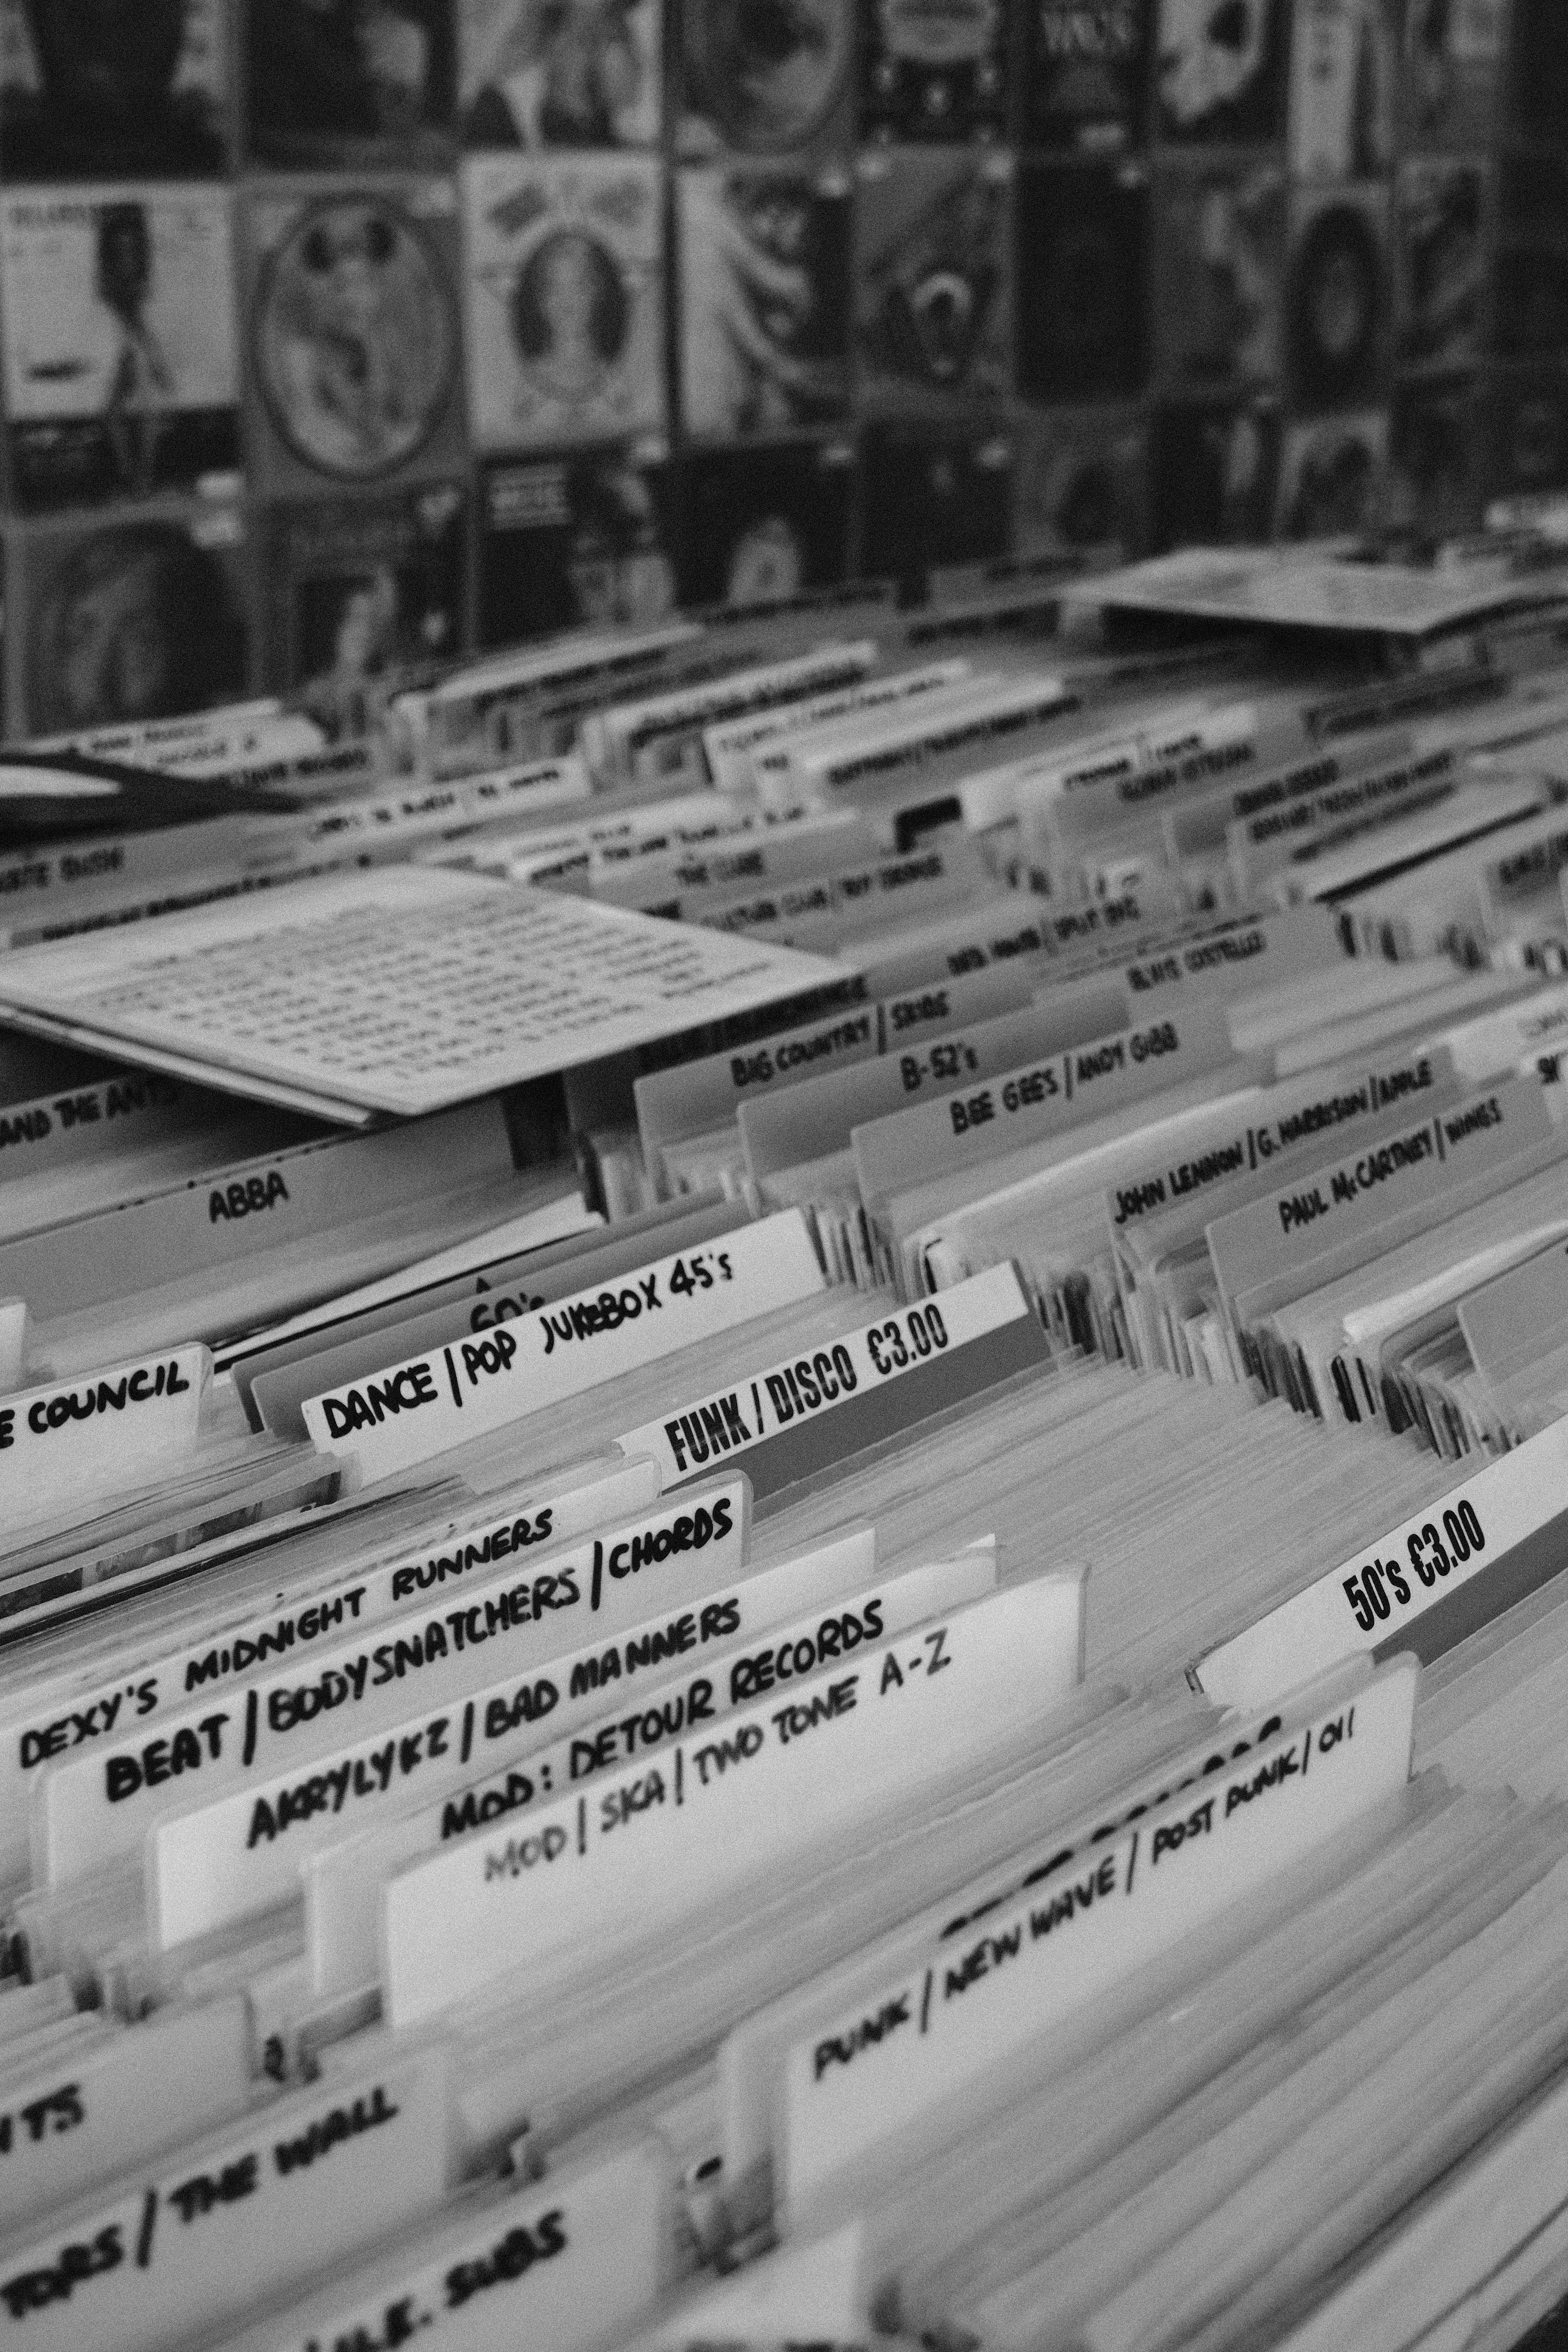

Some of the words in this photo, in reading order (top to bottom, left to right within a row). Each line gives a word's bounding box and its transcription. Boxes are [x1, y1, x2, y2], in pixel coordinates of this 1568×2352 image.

[1184, 930, 1267, 973] COSTELLO
[730, 1051, 775, 1087] BIG
[775, 1015, 871, 1072] COUNTRY
[949, 1089, 995, 1135] BEE
[1001, 1066, 1060, 1113] GEES
[1076, 1039, 1126, 1084] ANDY
[54, 1093, 101, 1128] THE
[208, 1171, 289, 1223] ABBA
[1113, 1178, 1167, 1226] JOHN
[1168, 1141, 1245, 1197] LENNON
[1277, 1187, 1331, 1234] PAUL
[28, 1361, 189, 1433] COUNCIL
[322, 1363, 438, 1439] DANCE
[664, 1393, 752, 1472] FUNK
[764, 1344, 858, 1423] DISCO
[866, 1303, 949, 1375] €3.00
[1342, 1559, 1411, 1631] 50's
[1407, 1499, 1485, 1587] €3.00
[20, 1678, 158, 1770] DEXY'S
[184, 1586, 367, 1692] MIDNIGHT
[392, 1508, 553, 1601] RUNNERS
[105, 1714, 230, 1803] BEAT
[268, 1568, 580, 1732] BODYSNATCHERS
[609, 1498, 733, 1579] CHORDS
[485, 1678, 559, 1738] BAD
[570, 1598, 741, 1699] MANNERS
[570, 1679, 715, 1780] DETOUR
[730, 1599, 884, 1704] RECORDS
[484, 1825, 567, 1882] MOD
[601, 1768, 665, 1833] SKA
[692, 1724, 764, 1785] TWO
[772, 1674, 859, 1744] TONE
[879, 1627, 951, 1695] A-Z
[812, 1993, 911, 2081] PUNK
[944, 1924, 1022, 1999] NEW
[1029, 1855, 1115, 1943] WAVE
[1152, 1798, 1216, 1865] POST
[169, 2153, 260, 2224] THE
[274, 2086, 399, 2176] WALL
